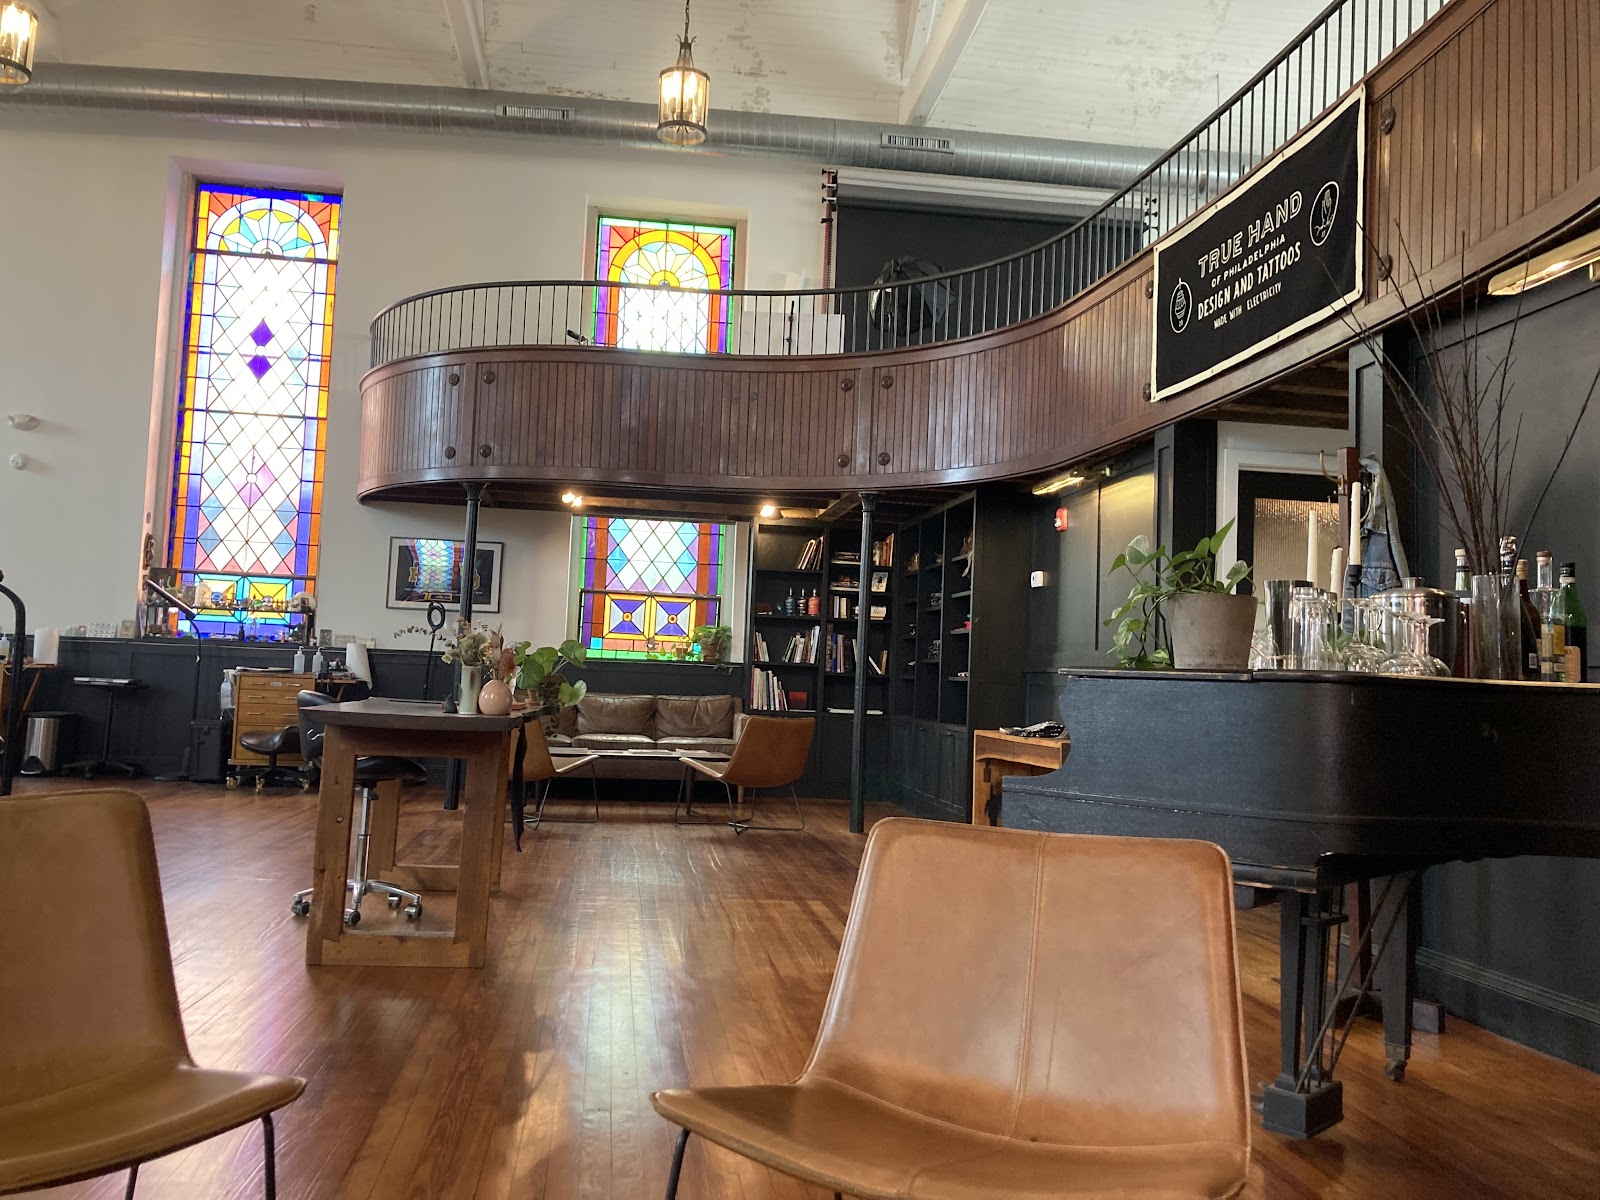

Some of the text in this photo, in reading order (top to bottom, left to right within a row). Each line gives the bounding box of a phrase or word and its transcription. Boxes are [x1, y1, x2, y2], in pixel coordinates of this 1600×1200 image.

[1198, 190, 1302, 278] TRUE HAND
[1211, 233, 1285, 288] OF PHILADELPHIA
[1198, 241, 1301, 320] DESIGN AND TATTOOS
[1213, 282, 1281, 329] MADE WITH ELECTRICITY
